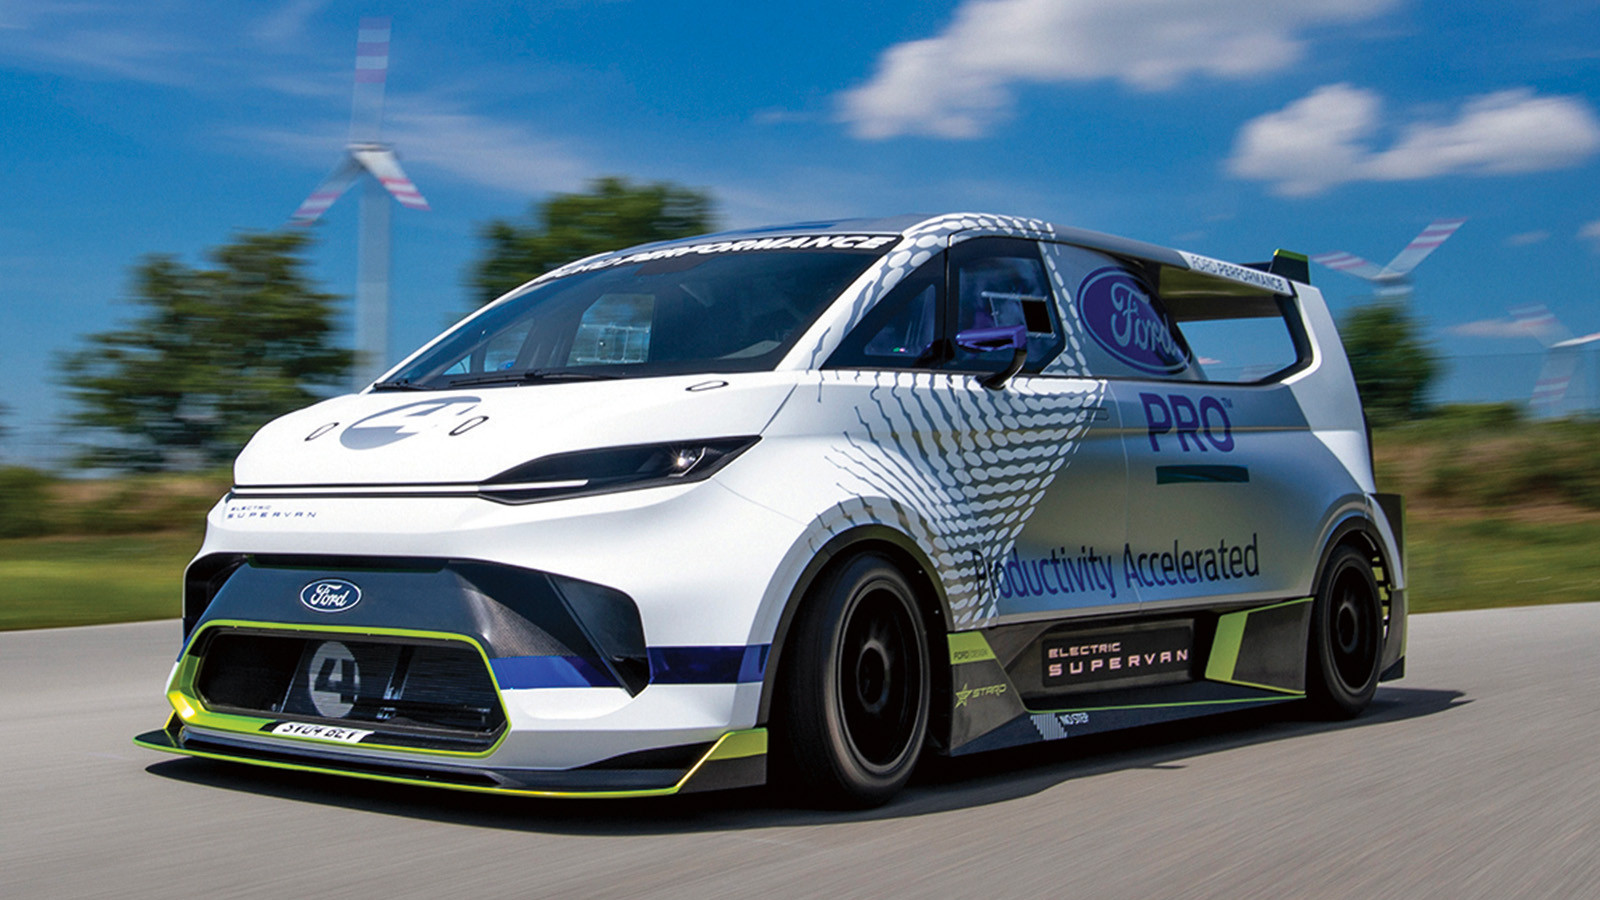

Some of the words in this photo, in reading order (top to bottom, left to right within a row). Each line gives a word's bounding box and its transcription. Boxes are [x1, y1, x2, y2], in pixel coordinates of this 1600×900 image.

[1110, 281, 1179, 355] Ford
[972, 545, 1117, 599] Productivity
[1123, 533, 1260, 588] Accelerated
[310, 584, 350, 607] Ford
[1048, 642, 1121, 658] ELECTRIC
[1048, 649, 1189, 677] SUPERVAN
